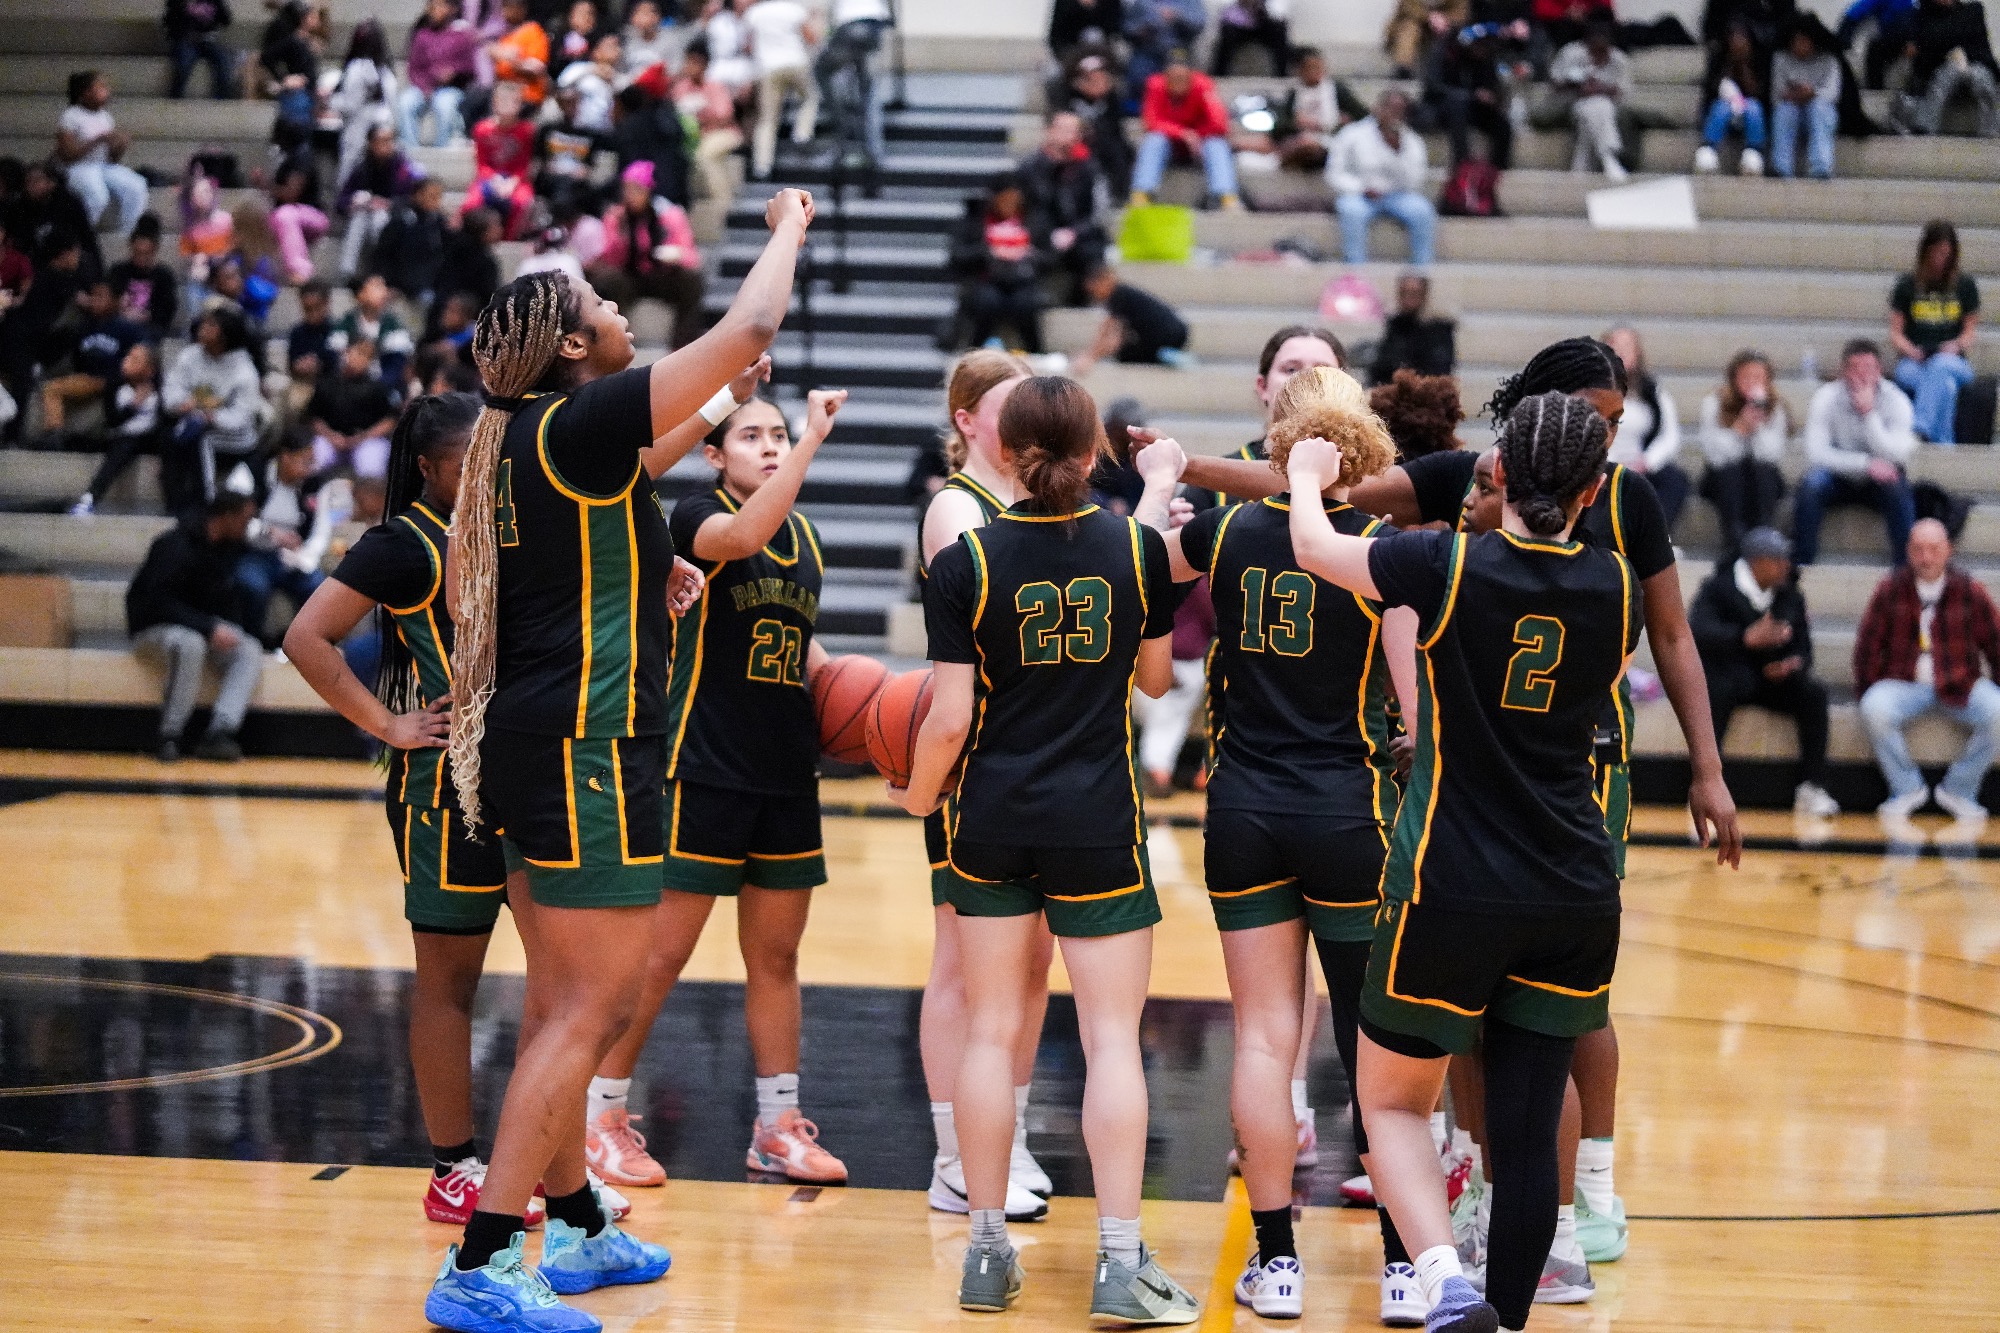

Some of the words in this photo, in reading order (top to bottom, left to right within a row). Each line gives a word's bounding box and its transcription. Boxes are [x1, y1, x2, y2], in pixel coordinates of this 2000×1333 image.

[746, 618, 804, 687] 22
[1014, 576, 1112, 667] 23
[1240, 567, 1316, 658] 13
[1500, 613, 1566, 712] 2
